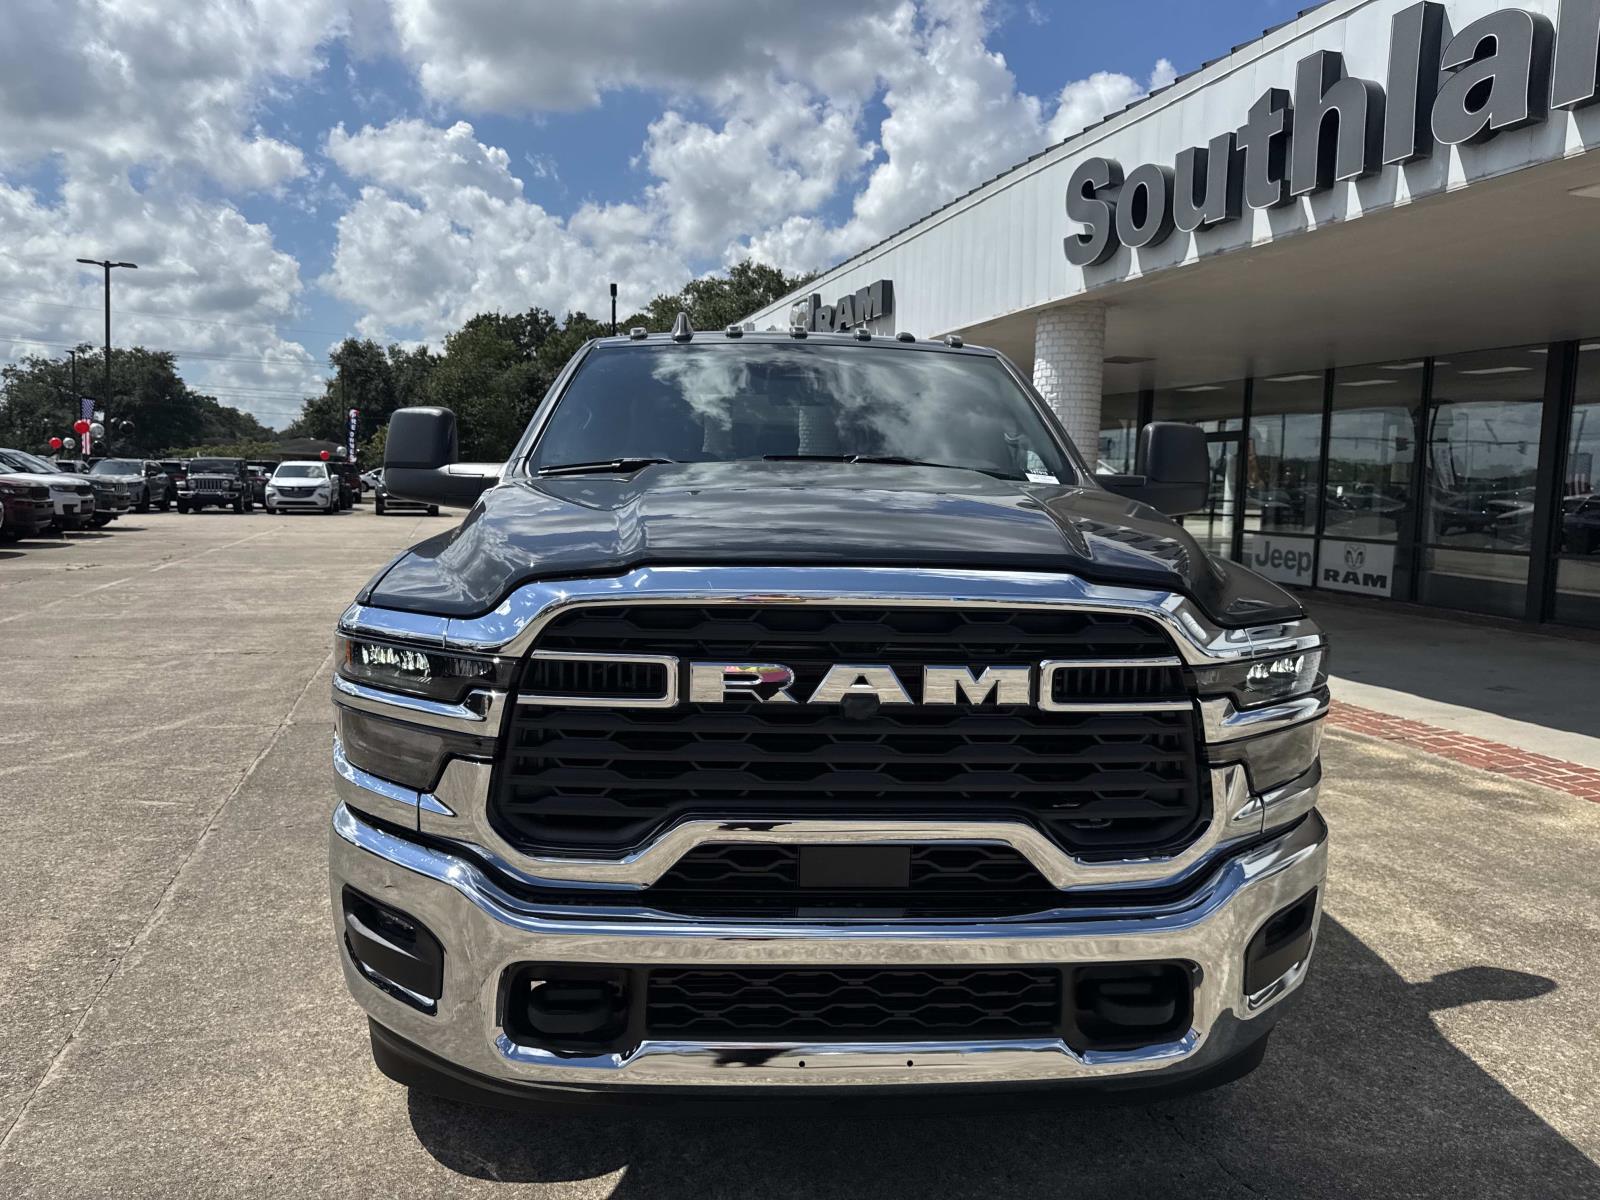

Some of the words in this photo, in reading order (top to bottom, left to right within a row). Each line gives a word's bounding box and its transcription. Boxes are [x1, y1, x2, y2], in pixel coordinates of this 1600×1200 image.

[814, 280, 893, 333] RAM
[1254, 541, 1312, 576] Jeep
[1323, 568, 1388, 589] RAM
[689, 661, 1032, 705] RAM
